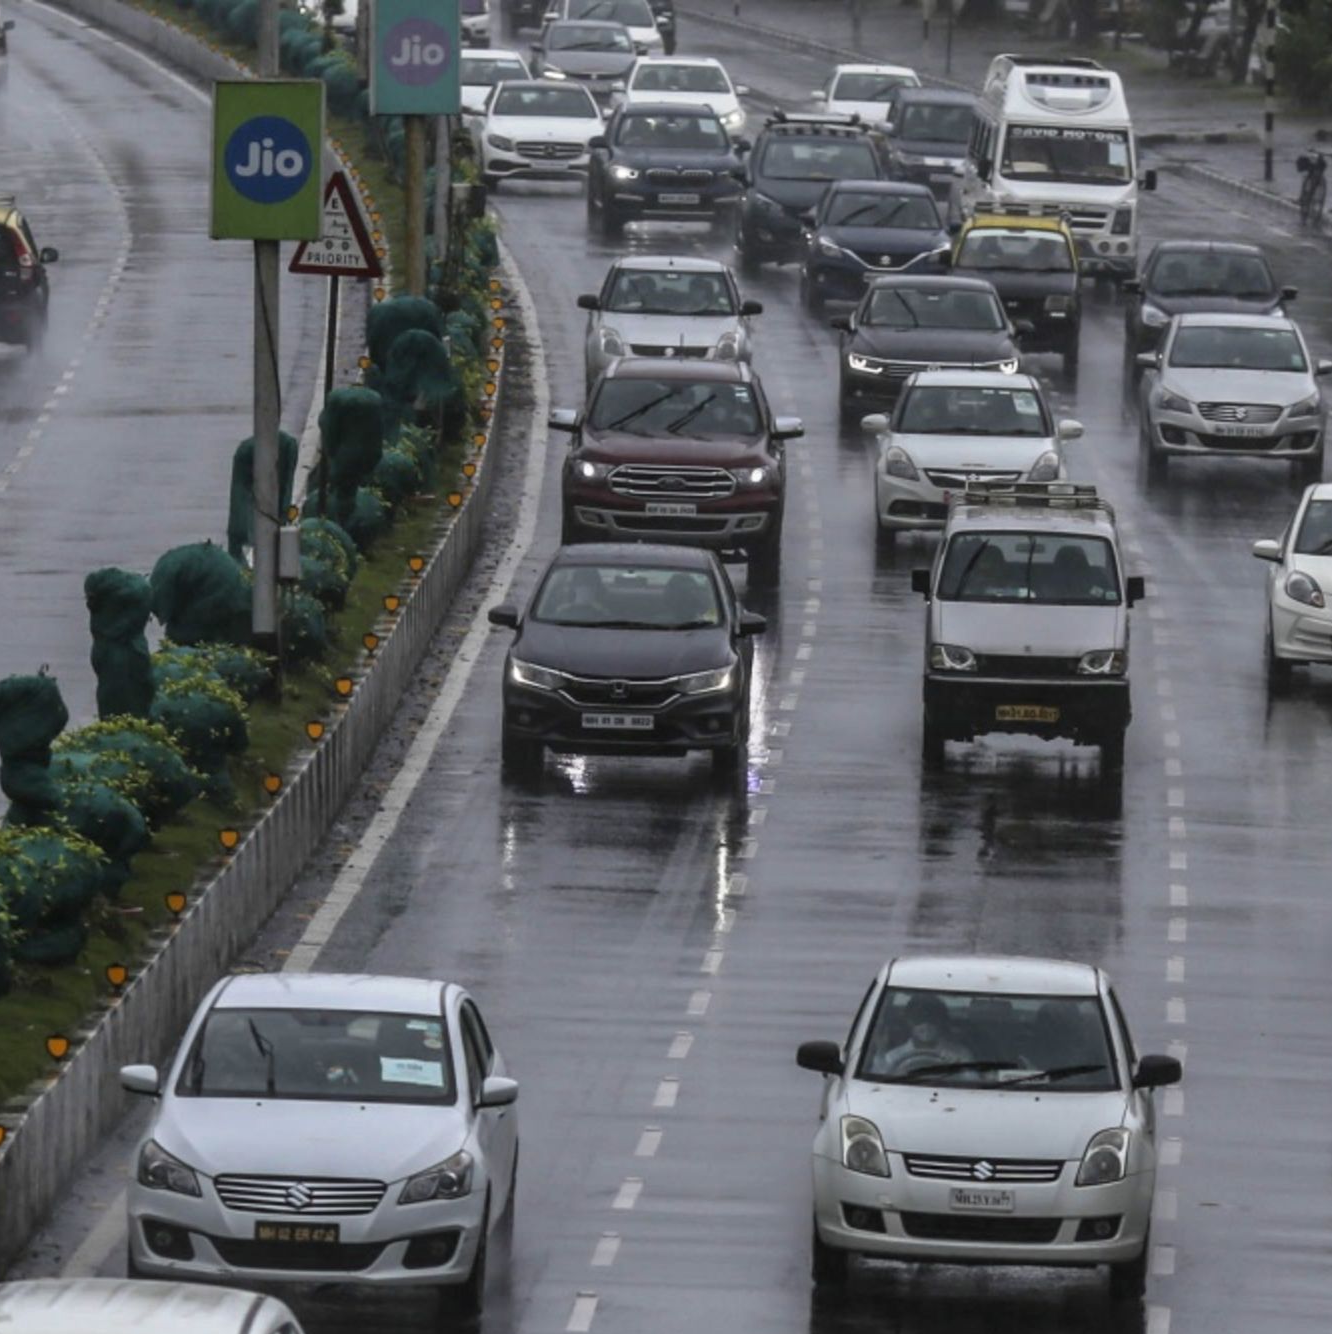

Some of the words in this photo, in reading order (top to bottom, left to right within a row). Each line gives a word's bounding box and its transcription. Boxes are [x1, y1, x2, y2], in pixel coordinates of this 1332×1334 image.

[391, 35, 446, 69] Jio
[235, 138, 304, 178] Jio
[307, 252, 361, 265] PRIORITY
